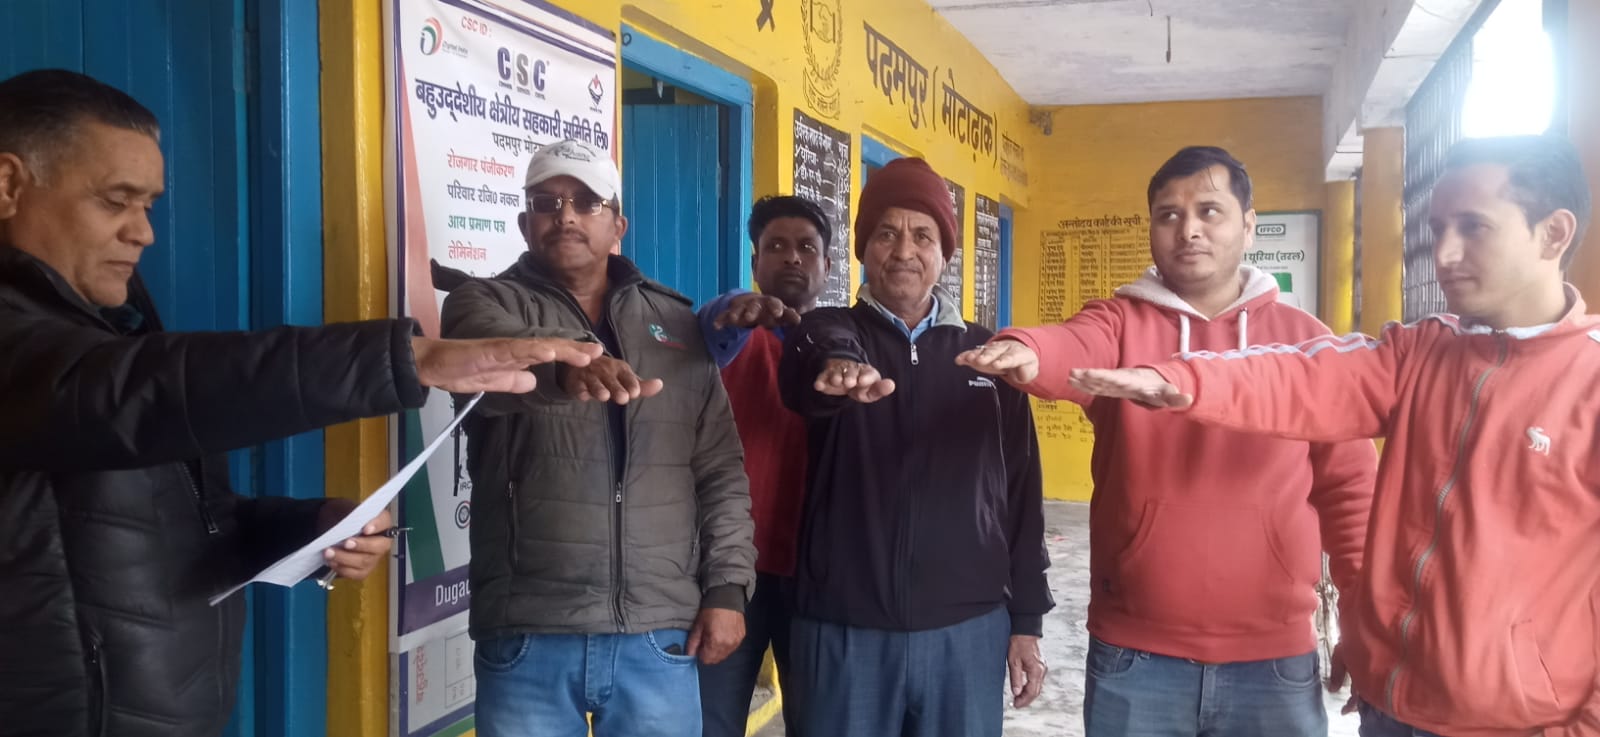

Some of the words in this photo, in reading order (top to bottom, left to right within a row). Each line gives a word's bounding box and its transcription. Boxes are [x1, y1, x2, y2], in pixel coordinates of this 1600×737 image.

[461, 16, 478, 31] CSC
[479, 22, 488, 36] ID
[497, 47, 546, 92] CSC
[863, 21, 929, 129] पदमपुर
[490, 92, 520, 127] क्षेत्रीय
[522, 108, 560, 138] सहकारी
[563, 114, 592, 144] समिति
[492, 132, 522, 157] पदमपुर
[447, 148, 478, 172] रोजगार
[480, 156, 514, 178] पंजीकरण
[447, 179, 476, 202] परिवार
[500, 192, 520, 207] नकल
[448, 214, 466, 230] आय
[468, 218, 492, 233] प्रमाण
[494, 220, 506, 234] पत्र
[448, 239, 487, 260] लेमिनेशन
[1248, 250, 1274, 264] यूरिया
[1276, 250, 1305, 262] (तरल)
